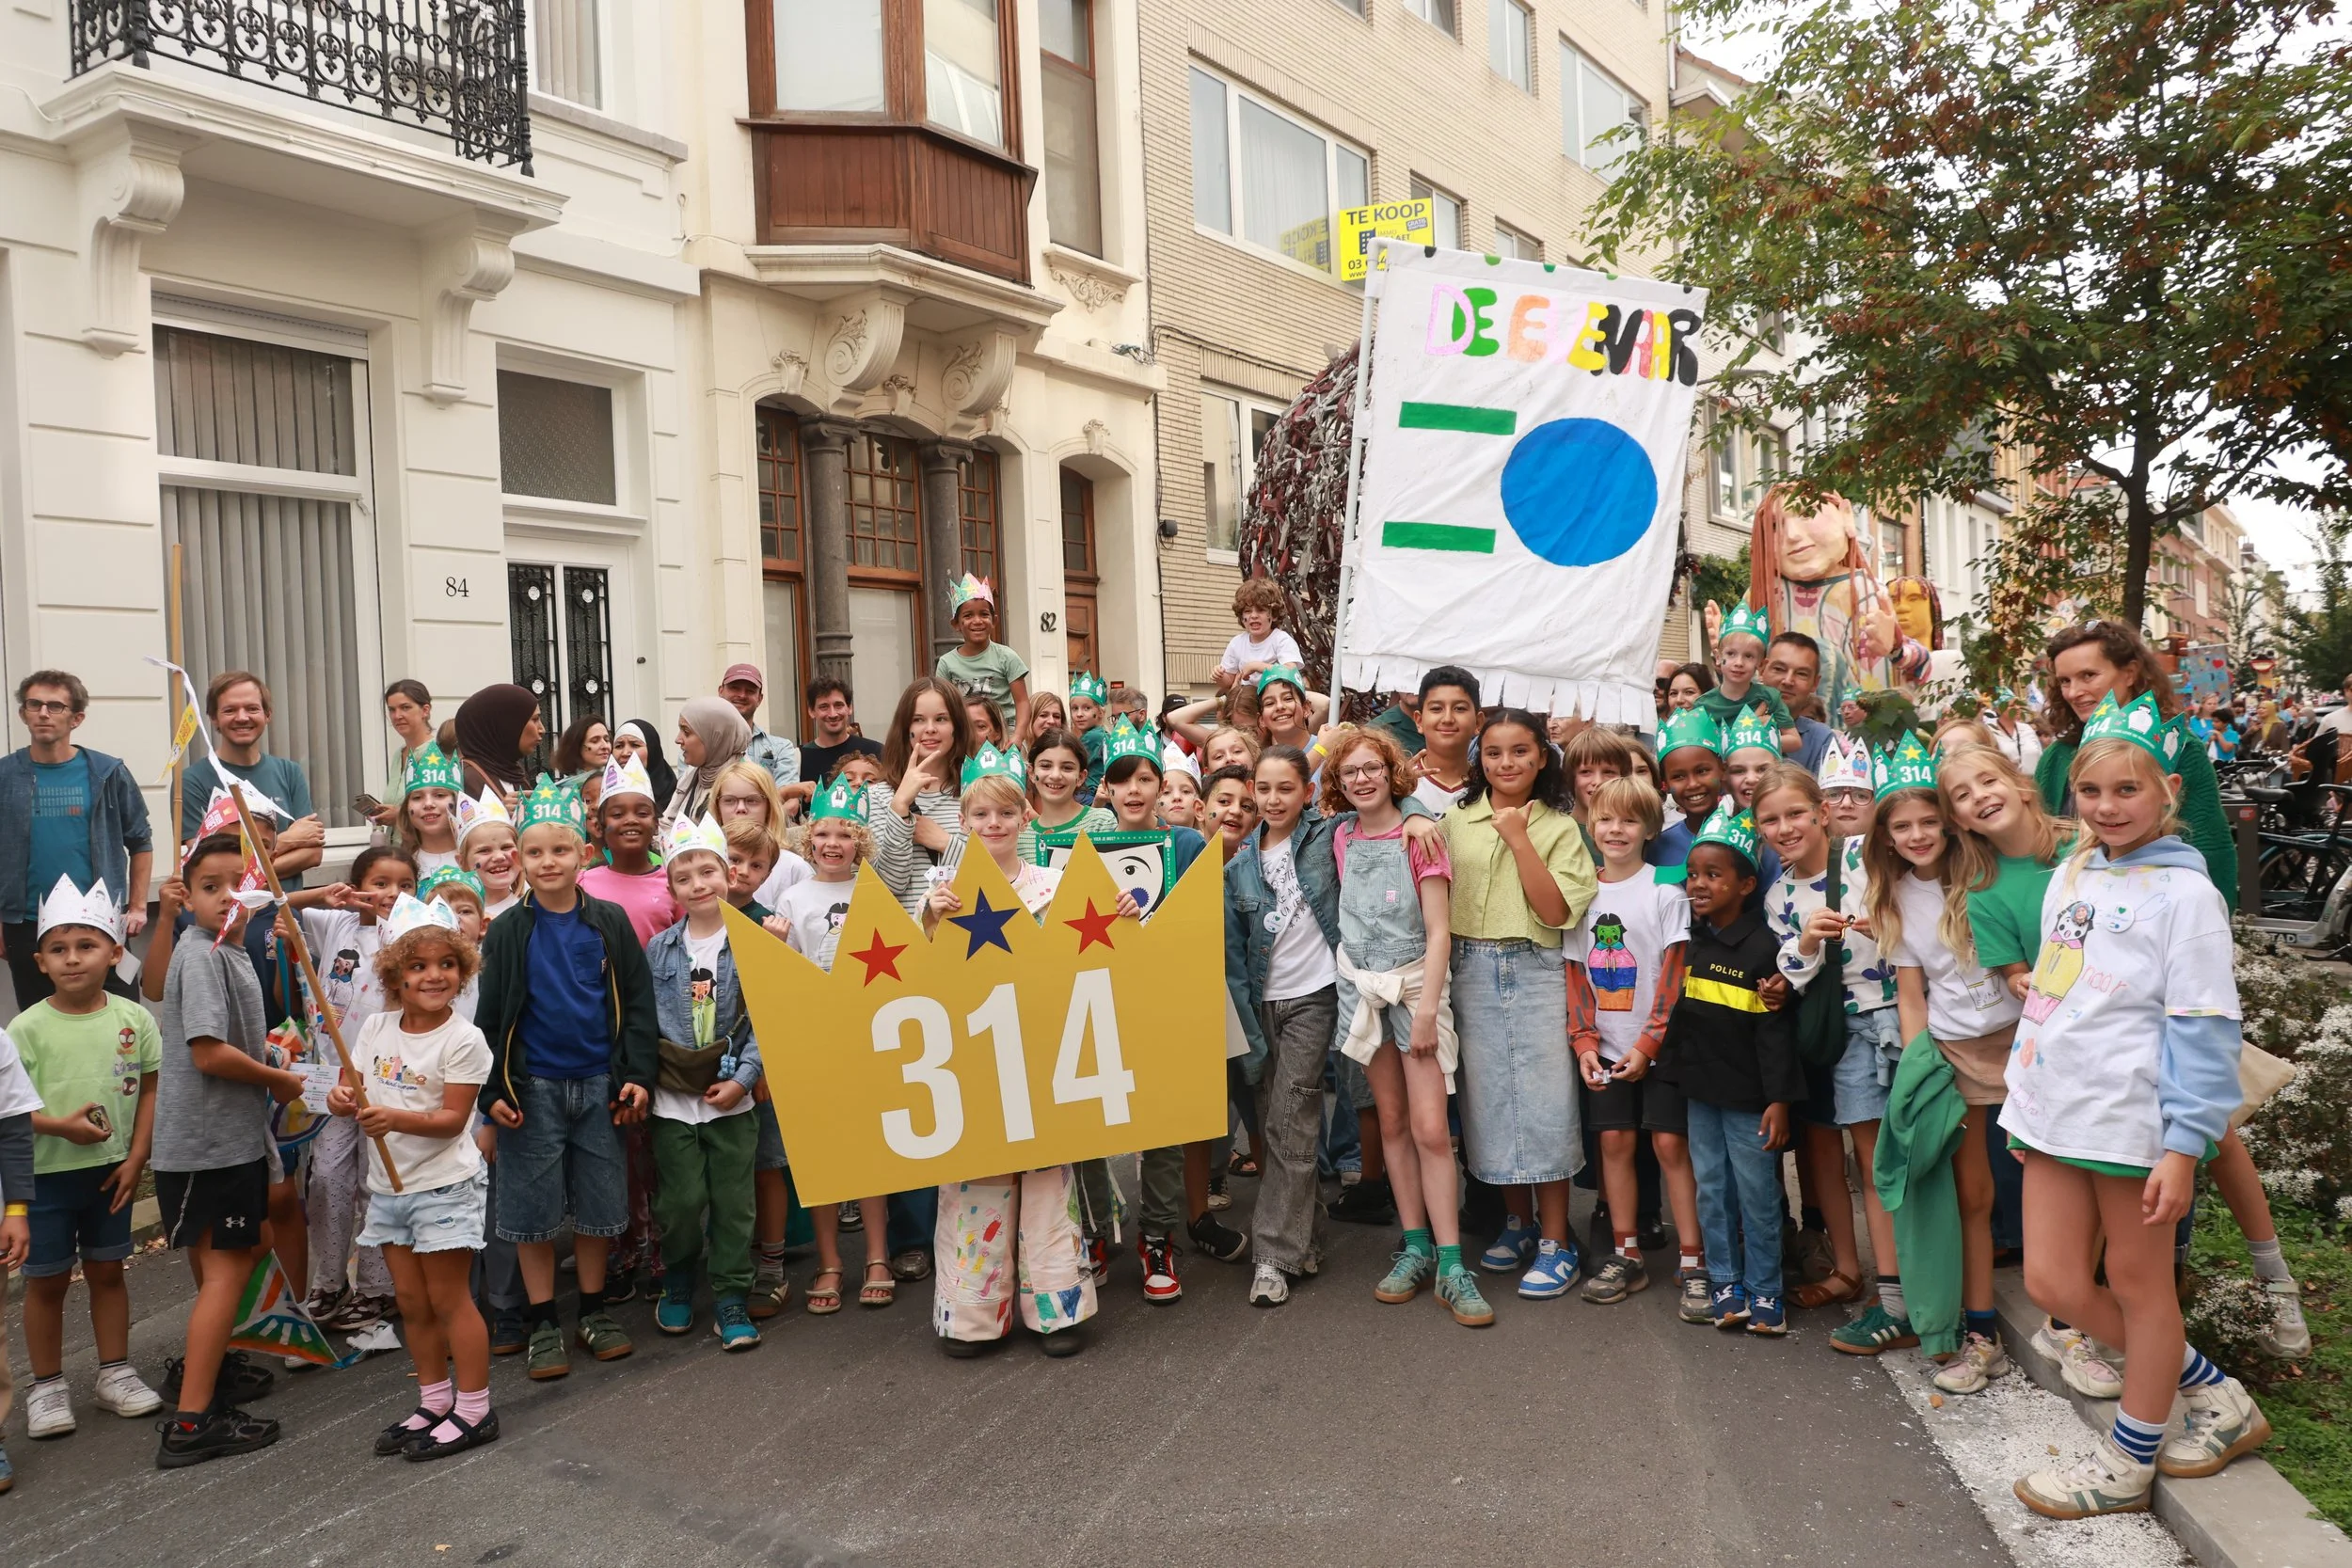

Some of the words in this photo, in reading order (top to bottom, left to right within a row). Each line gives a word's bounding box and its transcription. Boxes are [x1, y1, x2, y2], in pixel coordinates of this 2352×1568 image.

[1346, 210, 1369, 225] TE
[1374, 202, 1425, 222] KOOP
[1348, 259, 1362, 270] 03
[1424, 283, 1500, 356] DE
[1507, 294, 1702, 387] EVENAAR
[446, 576, 469, 598] 84
[1041, 611, 1057, 632] 82
[1112, 737, 1136, 756] 314
[1735, 730, 1762, 745] 314
[421, 768, 447, 784] 314
[1899, 765, 1932, 783] 314
[532, 803, 562, 819] 314
[1728, 829, 1755, 853] 314
[433, 872, 461, 884] 314
[2268, 932, 2296, 943] TAD
[1709, 963, 1744, 979] POLICE
[871, 967, 1136, 1160] 314
